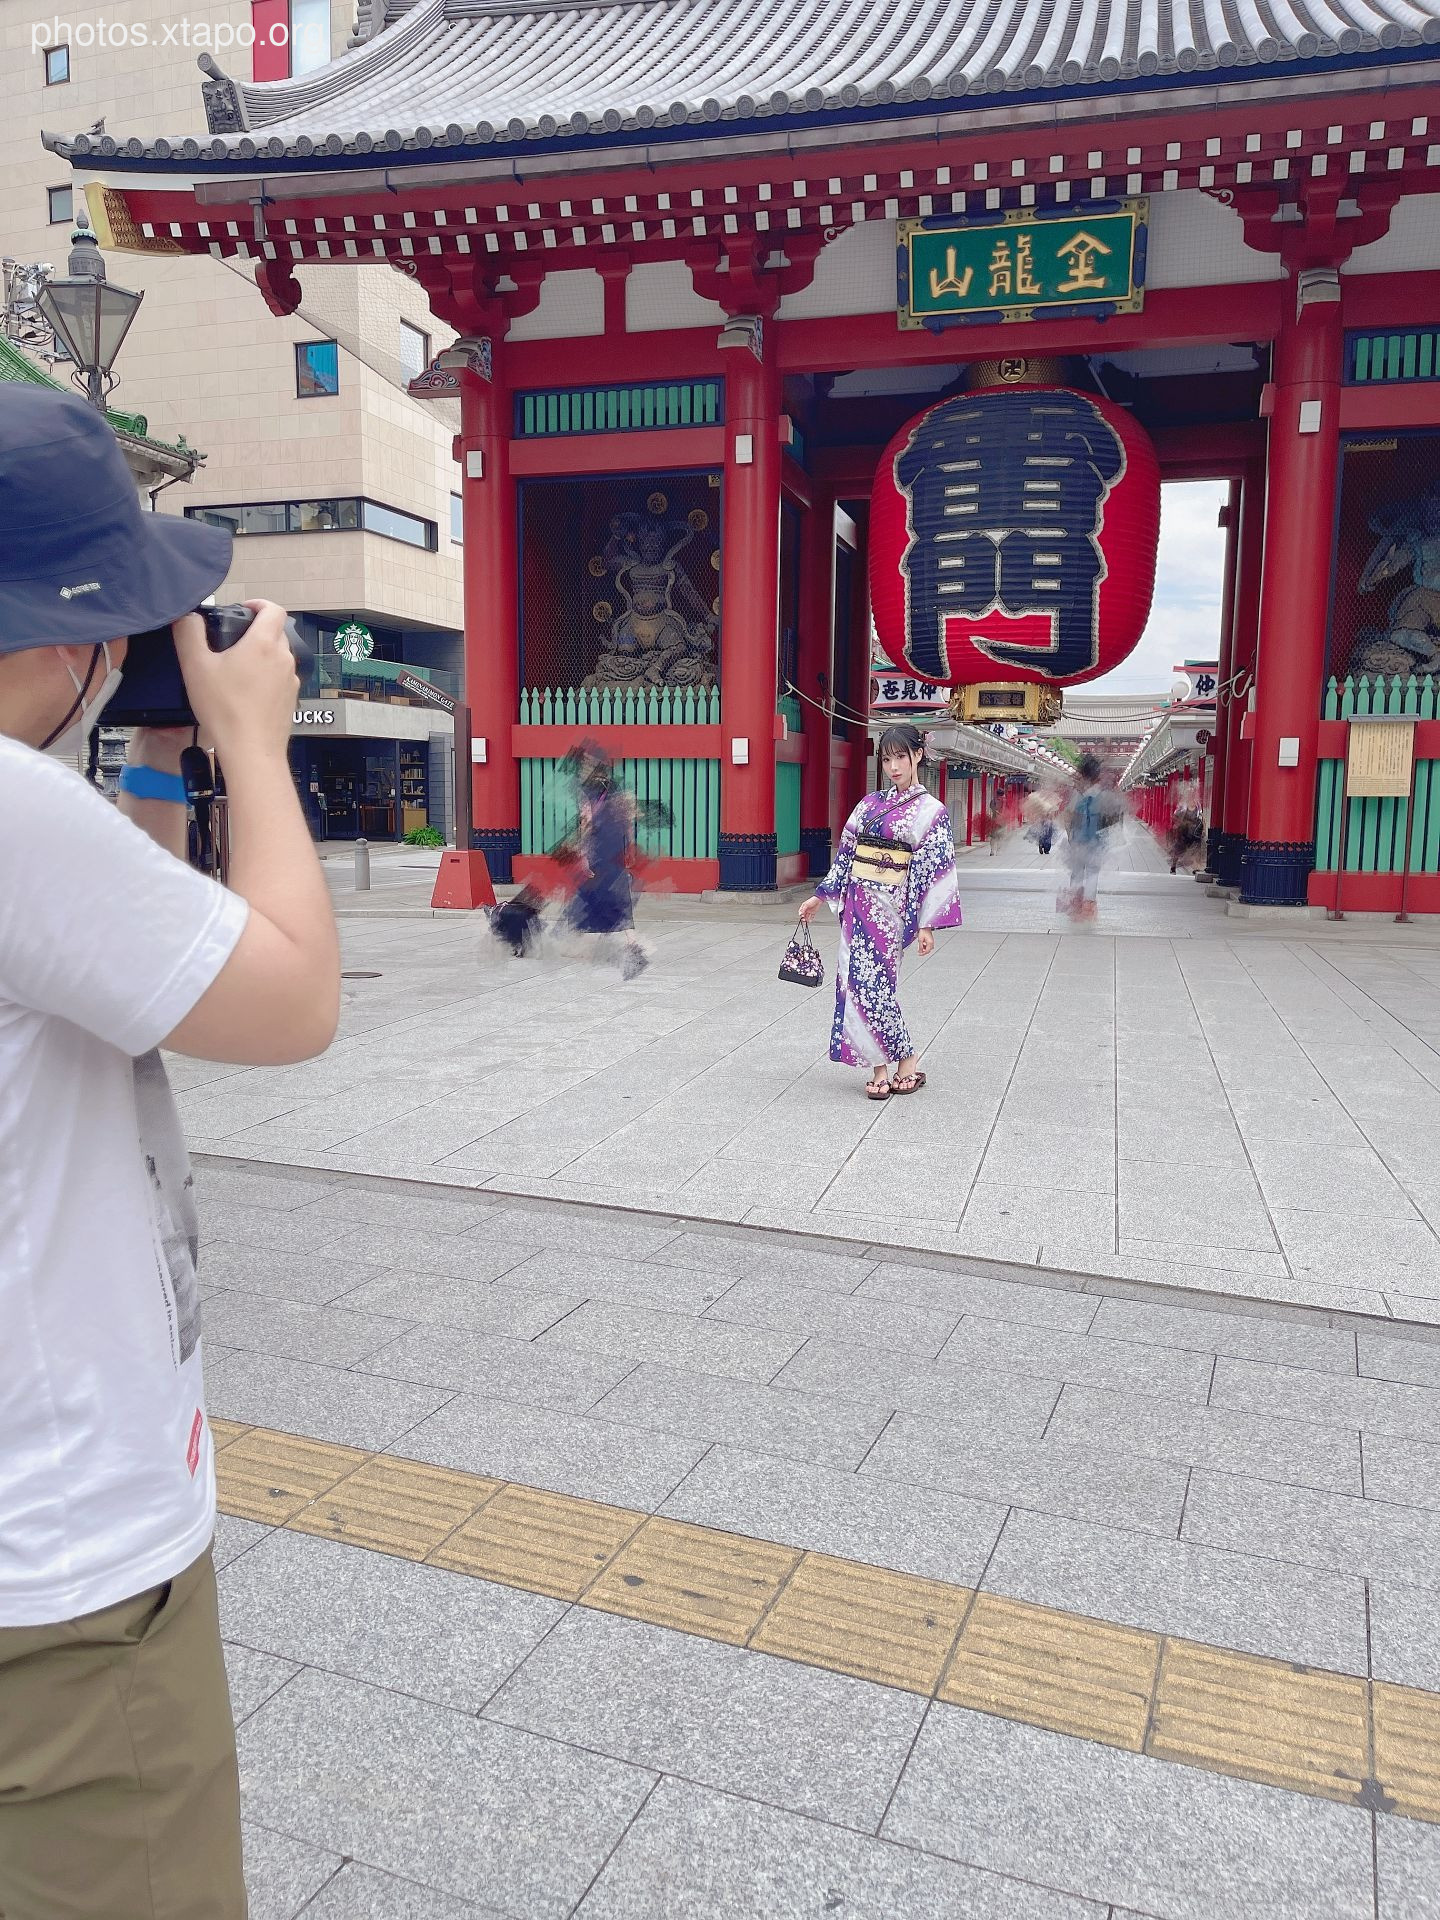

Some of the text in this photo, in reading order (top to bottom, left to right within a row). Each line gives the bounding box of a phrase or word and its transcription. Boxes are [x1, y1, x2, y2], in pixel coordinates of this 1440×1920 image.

[405, 677, 441, 700] KAMINARIMON
[440, 696, 455, 708] GATE
[292, 710, 334, 724] UCKS
